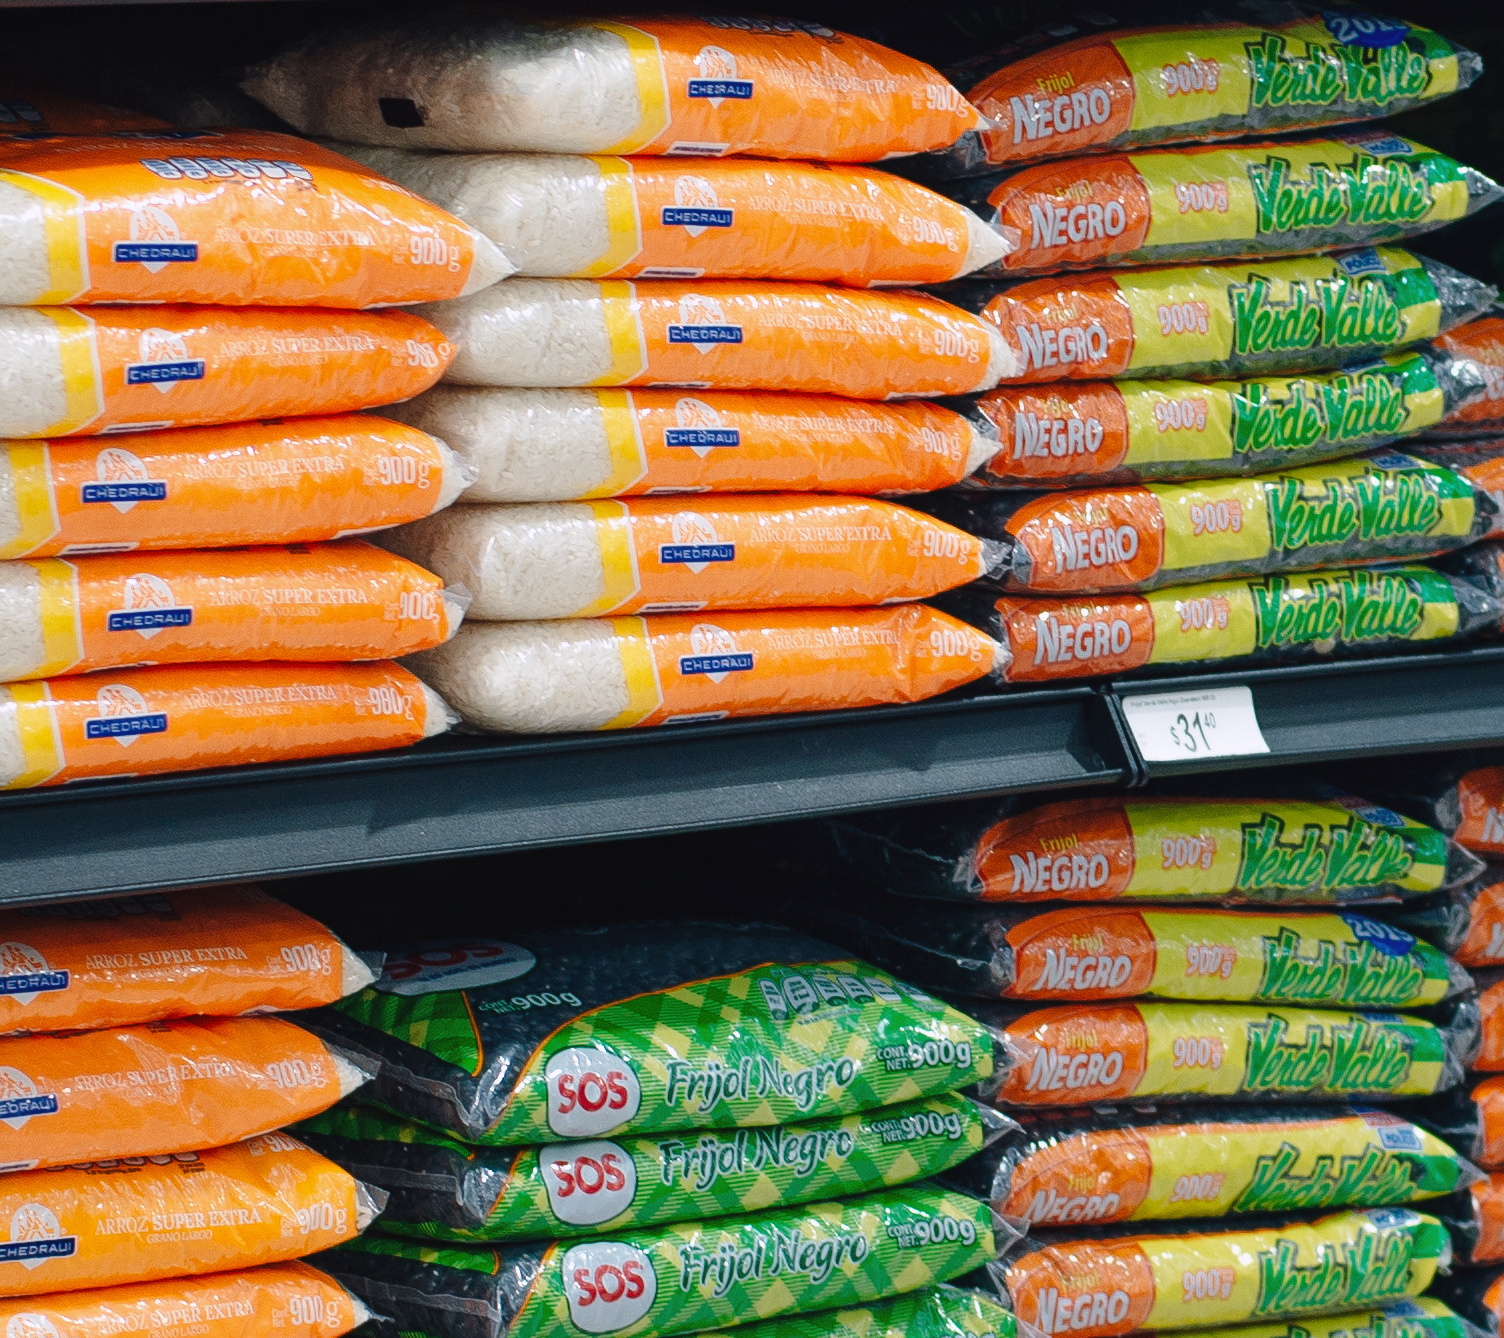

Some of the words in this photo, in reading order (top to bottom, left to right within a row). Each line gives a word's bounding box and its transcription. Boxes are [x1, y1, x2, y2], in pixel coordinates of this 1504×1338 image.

[1249, 36, 1340, 103] Verde
[1341, 37, 1431, 102] Valle
[1009, 89, 1110, 143] NEGRO
[1253, 157, 1344, 230] Verde
[1347, 155, 1435, 225] Valle
[1030, 201, 1125, 247] NEGRO
[1232, 275, 1318, 354] Verde
[1320, 273, 1403, 348] Valle
[1017, 324, 1107, 370] NEGRO
[1232, 385, 1321, 452] Verde
[1324, 373, 1407, 441] Valle
[1013, 414, 1103, 457] NEGRO
[1266, 475, 1357, 547] Verde
[1359, 470, 1437, 536] Valle
[1051, 526, 1137, 571] NEGRO
[1034, 619, 1131, 665] NEGRO
[1009, 856, 1109, 892] NEGRO
[1242, 816, 1323, 890] Verde
[1324, 821, 1414, 884] Valle
[138, 950, 190, 966] SUPER
[194, 946, 247, 962] EXTRA
[1039, 950, 1131, 989] NEGRO
[909, 1038, 972, 1073] 900g
[1026, 1049, 1124, 1090] NEGRO
[1248, 1018, 1324, 1089] Verde
[1327, 1024, 1411, 1091] Valle
[556, 1071, 629, 1114] SOS
[664, 1059, 752, 1111] Frijol
[754, 1058, 856, 1106] Negro
[901, 1113, 963, 1148] 900g
[555, 1153, 625, 1196] SOS
[659, 1134, 747, 1191] Frijol
[753, 1127, 853, 1177] Negro
[151, 1212, 202, 1231] SUPER
[207, 1209, 262, 1227] EXTRA
[915, 1218, 977, 1252] 900g
[573, 1262, 646, 1305] SOS
[679, 1236, 763, 1293] Frijol
[769, 1231, 868, 1280] Negro
[1036, 1291, 1129, 1333] NEGRO
